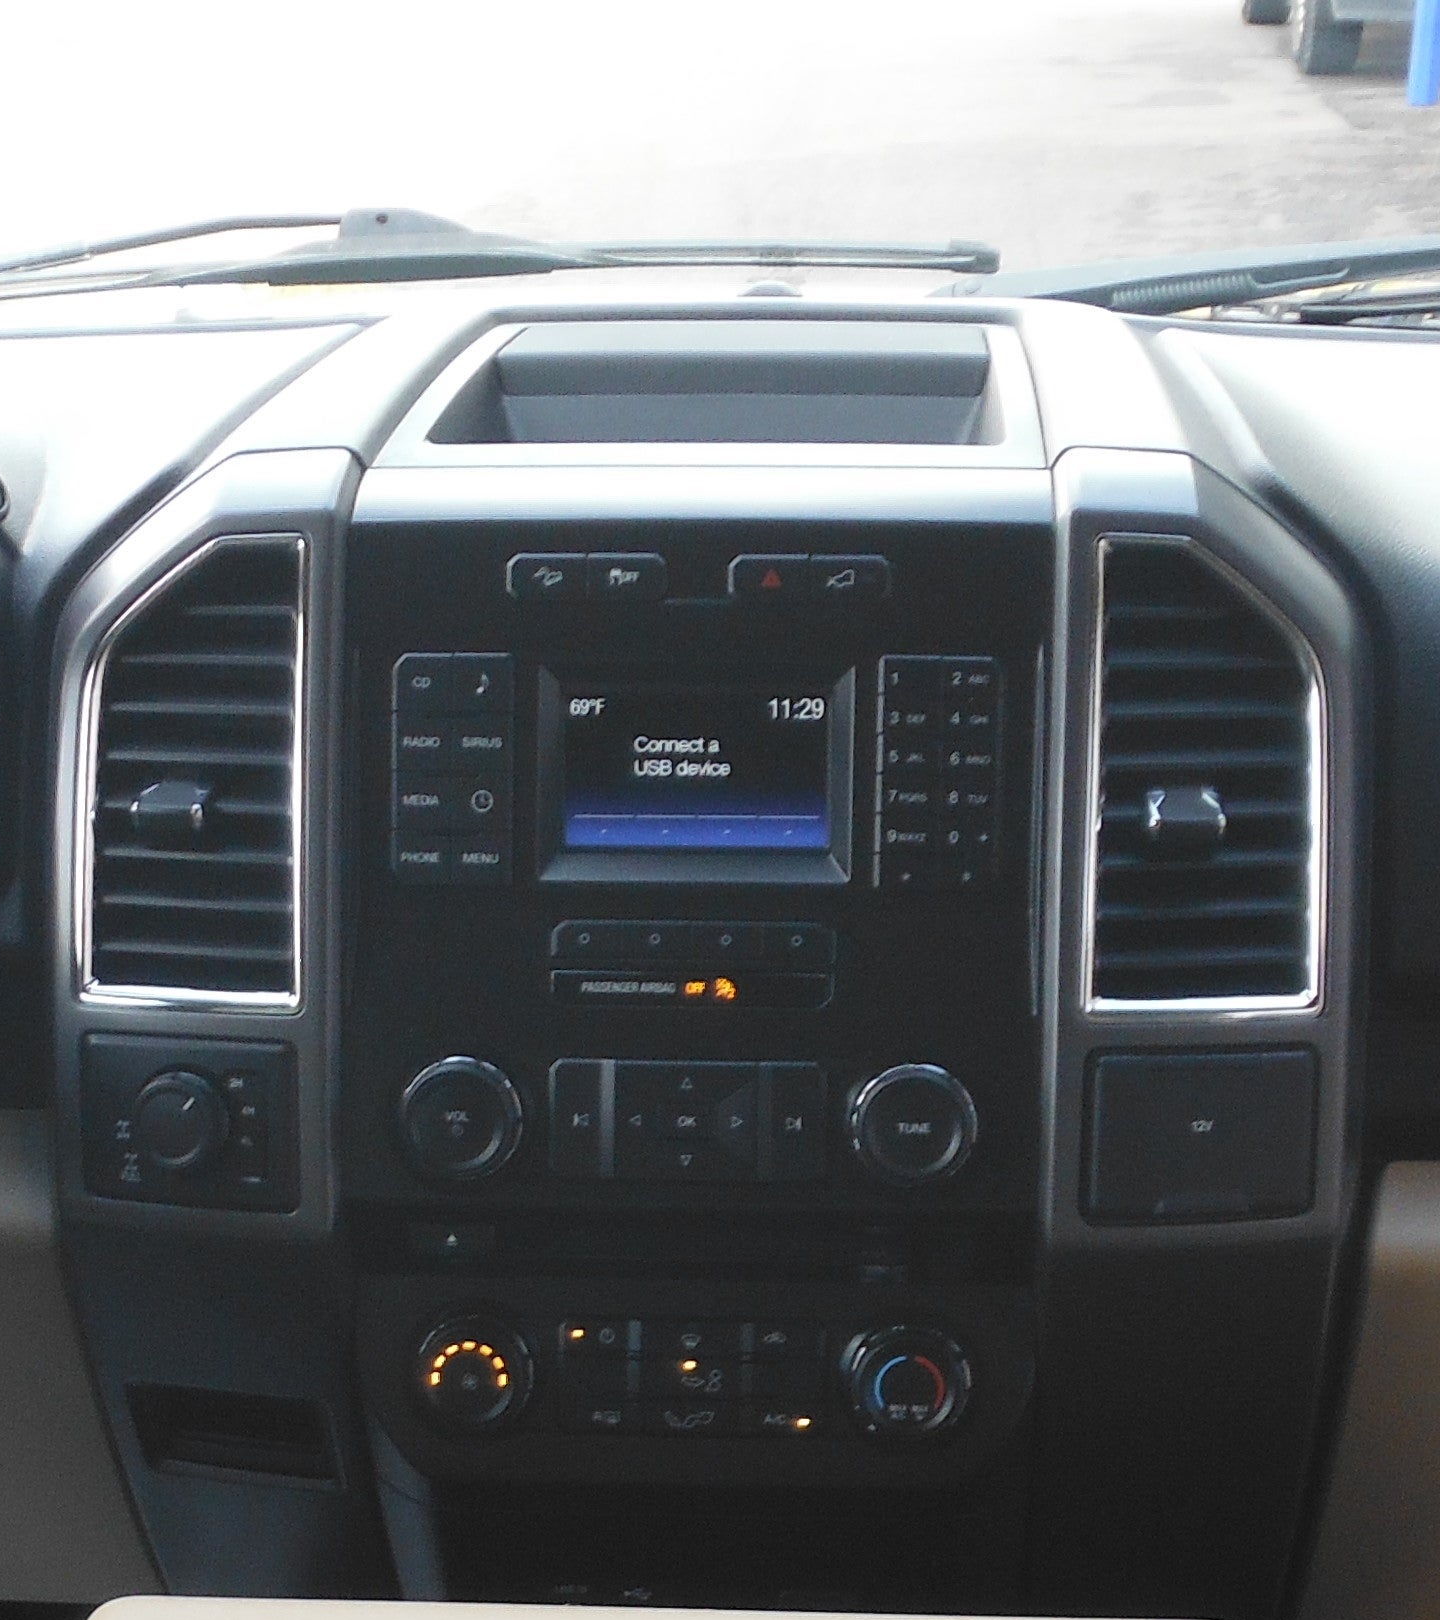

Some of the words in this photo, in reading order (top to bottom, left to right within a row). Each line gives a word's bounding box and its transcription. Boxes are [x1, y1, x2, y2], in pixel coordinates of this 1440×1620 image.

[411, 675, 432, 689] CD
[951, 671, 962, 686] 2
[767, 697, 825, 720] 11:29
[890, 711, 901, 726] 3
[950, 711, 961, 726] 4
[402, 735, 441, 749] RADIO
[462, 736, 503, 749] SIRIUS
[633, 736, 705, 754] Connect
[707, 740, 720, 754] a
[889, 749, 900, 764] 5
[949, 751, 961, 767] 6
[633, 759, 673, 778] USB
[675, 759, 731, 778] device
[889, 788, 899, 803] 7
[949, 790, 960, 805] 8
[887, 828, 898, 843] 9
[949, 830, 960, 845] 0
[400, 851, 441, 864] PHONE
[462, 852, 500, 865] MENU
[581, 981, 639, 994] PASSENGER
[640, 982, 677, 994] AIRBAG
[685, 981, 707, 995] OFF
[444, 1110, 472, 1122] VOL
[677, 1115, 697, 1128] OK
[898, 1121, 932, 1135] TUNE
